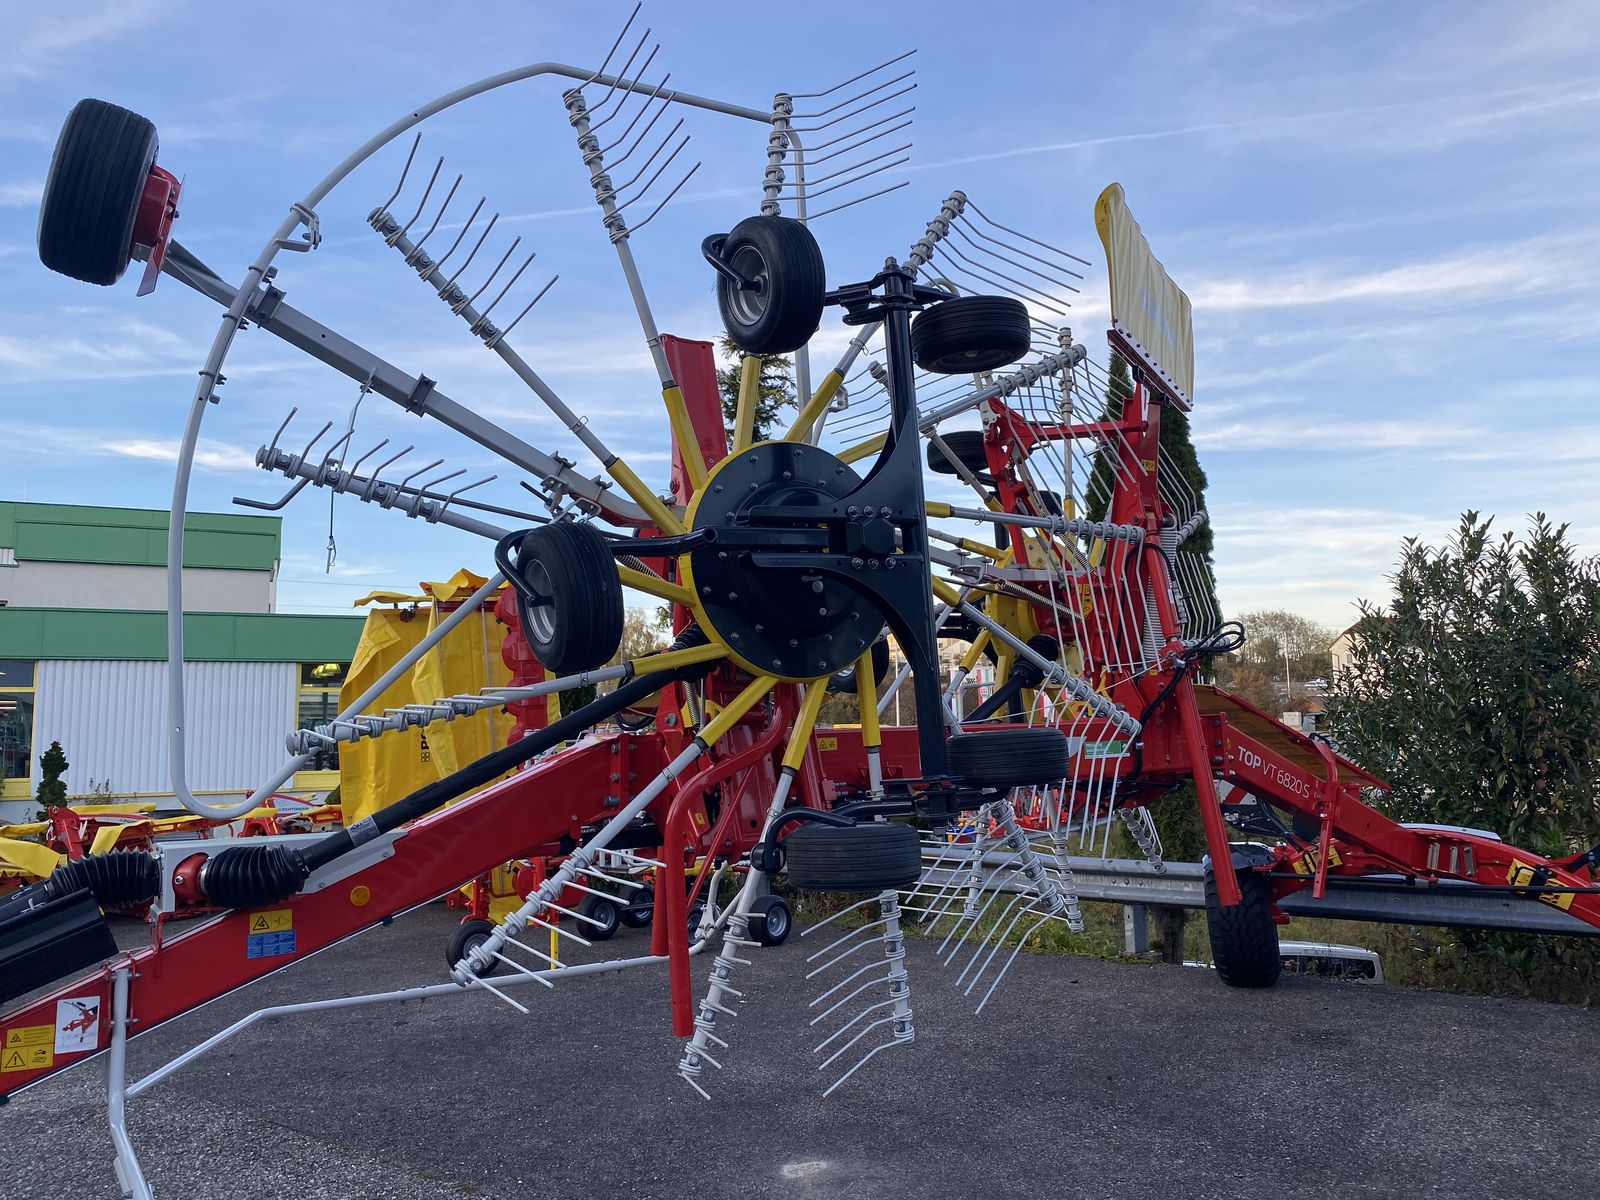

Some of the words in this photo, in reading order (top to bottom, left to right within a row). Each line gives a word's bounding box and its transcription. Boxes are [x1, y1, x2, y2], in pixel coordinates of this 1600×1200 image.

[1238, 746, 1261, 768] TOP
[1263, 760, 1277, 779] VT
[1277, 770, 1302, 794] 6820
[1303, 784, 1310, 798] S
